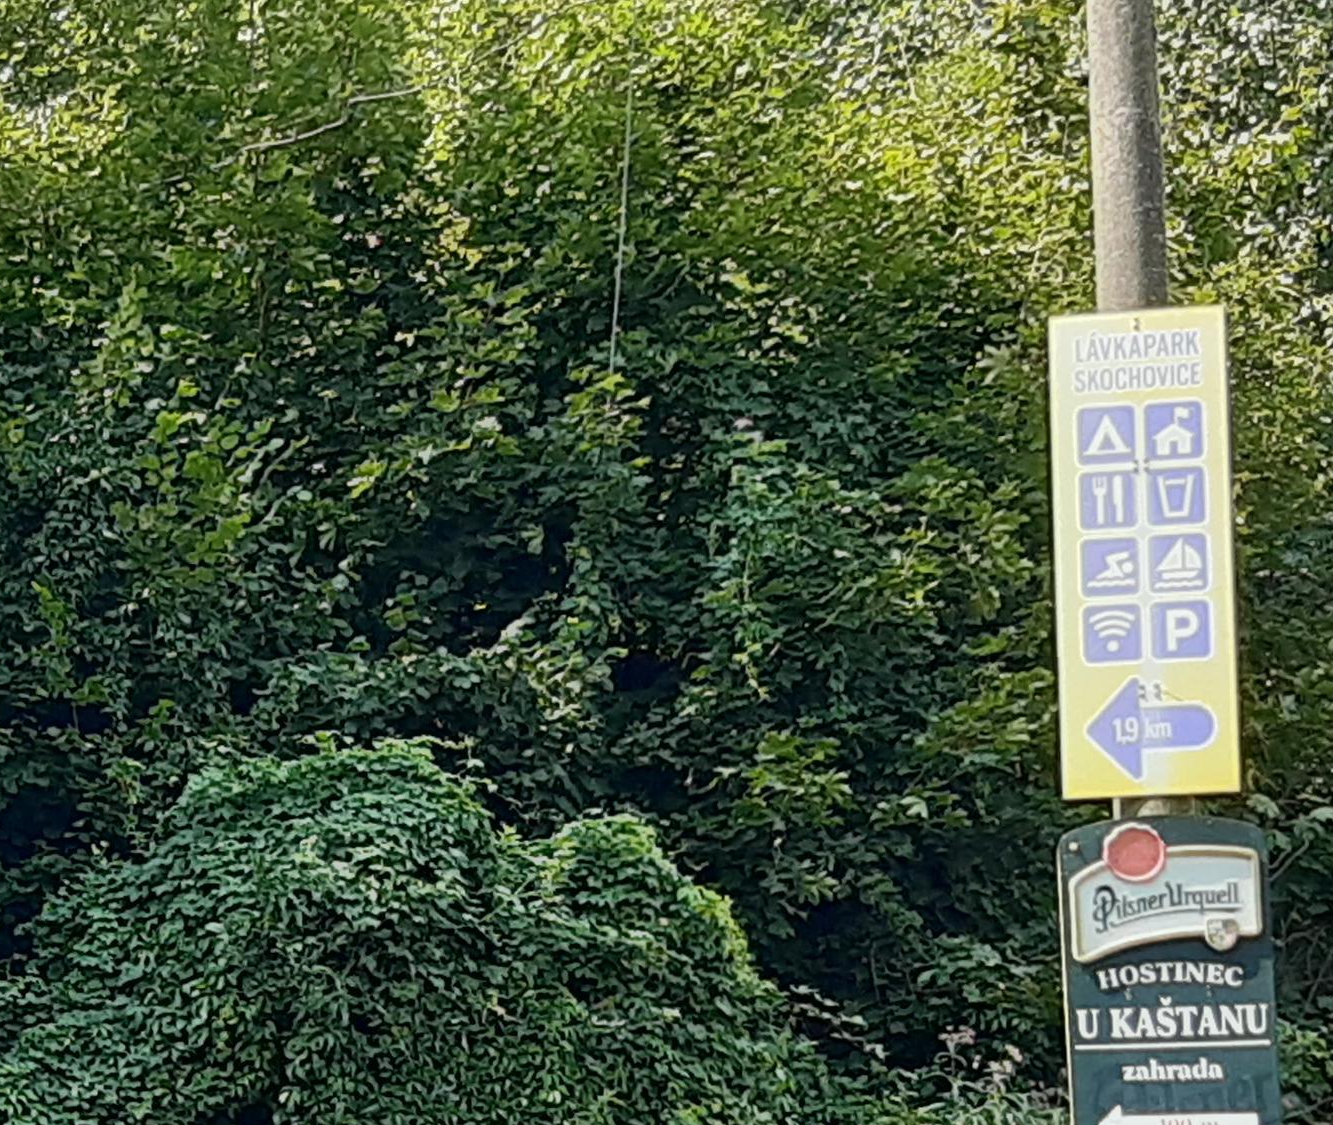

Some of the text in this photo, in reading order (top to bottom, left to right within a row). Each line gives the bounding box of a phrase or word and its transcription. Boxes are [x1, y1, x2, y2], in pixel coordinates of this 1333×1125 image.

[1075, 330, 1200, 363] LÁVKAPARK
[1074, 362, 1201, 393] SKOCHOVICE
[1144, 719, 1173, 741] km
[1092, 881, 1241, 934] Pilsner Urquell
[1096, 960, 1245, 990] HOSTINEC
[1076, 996, 1269, 1040] U KAŠTANU
[1121, 1057, 1224, 1082] zahrada
